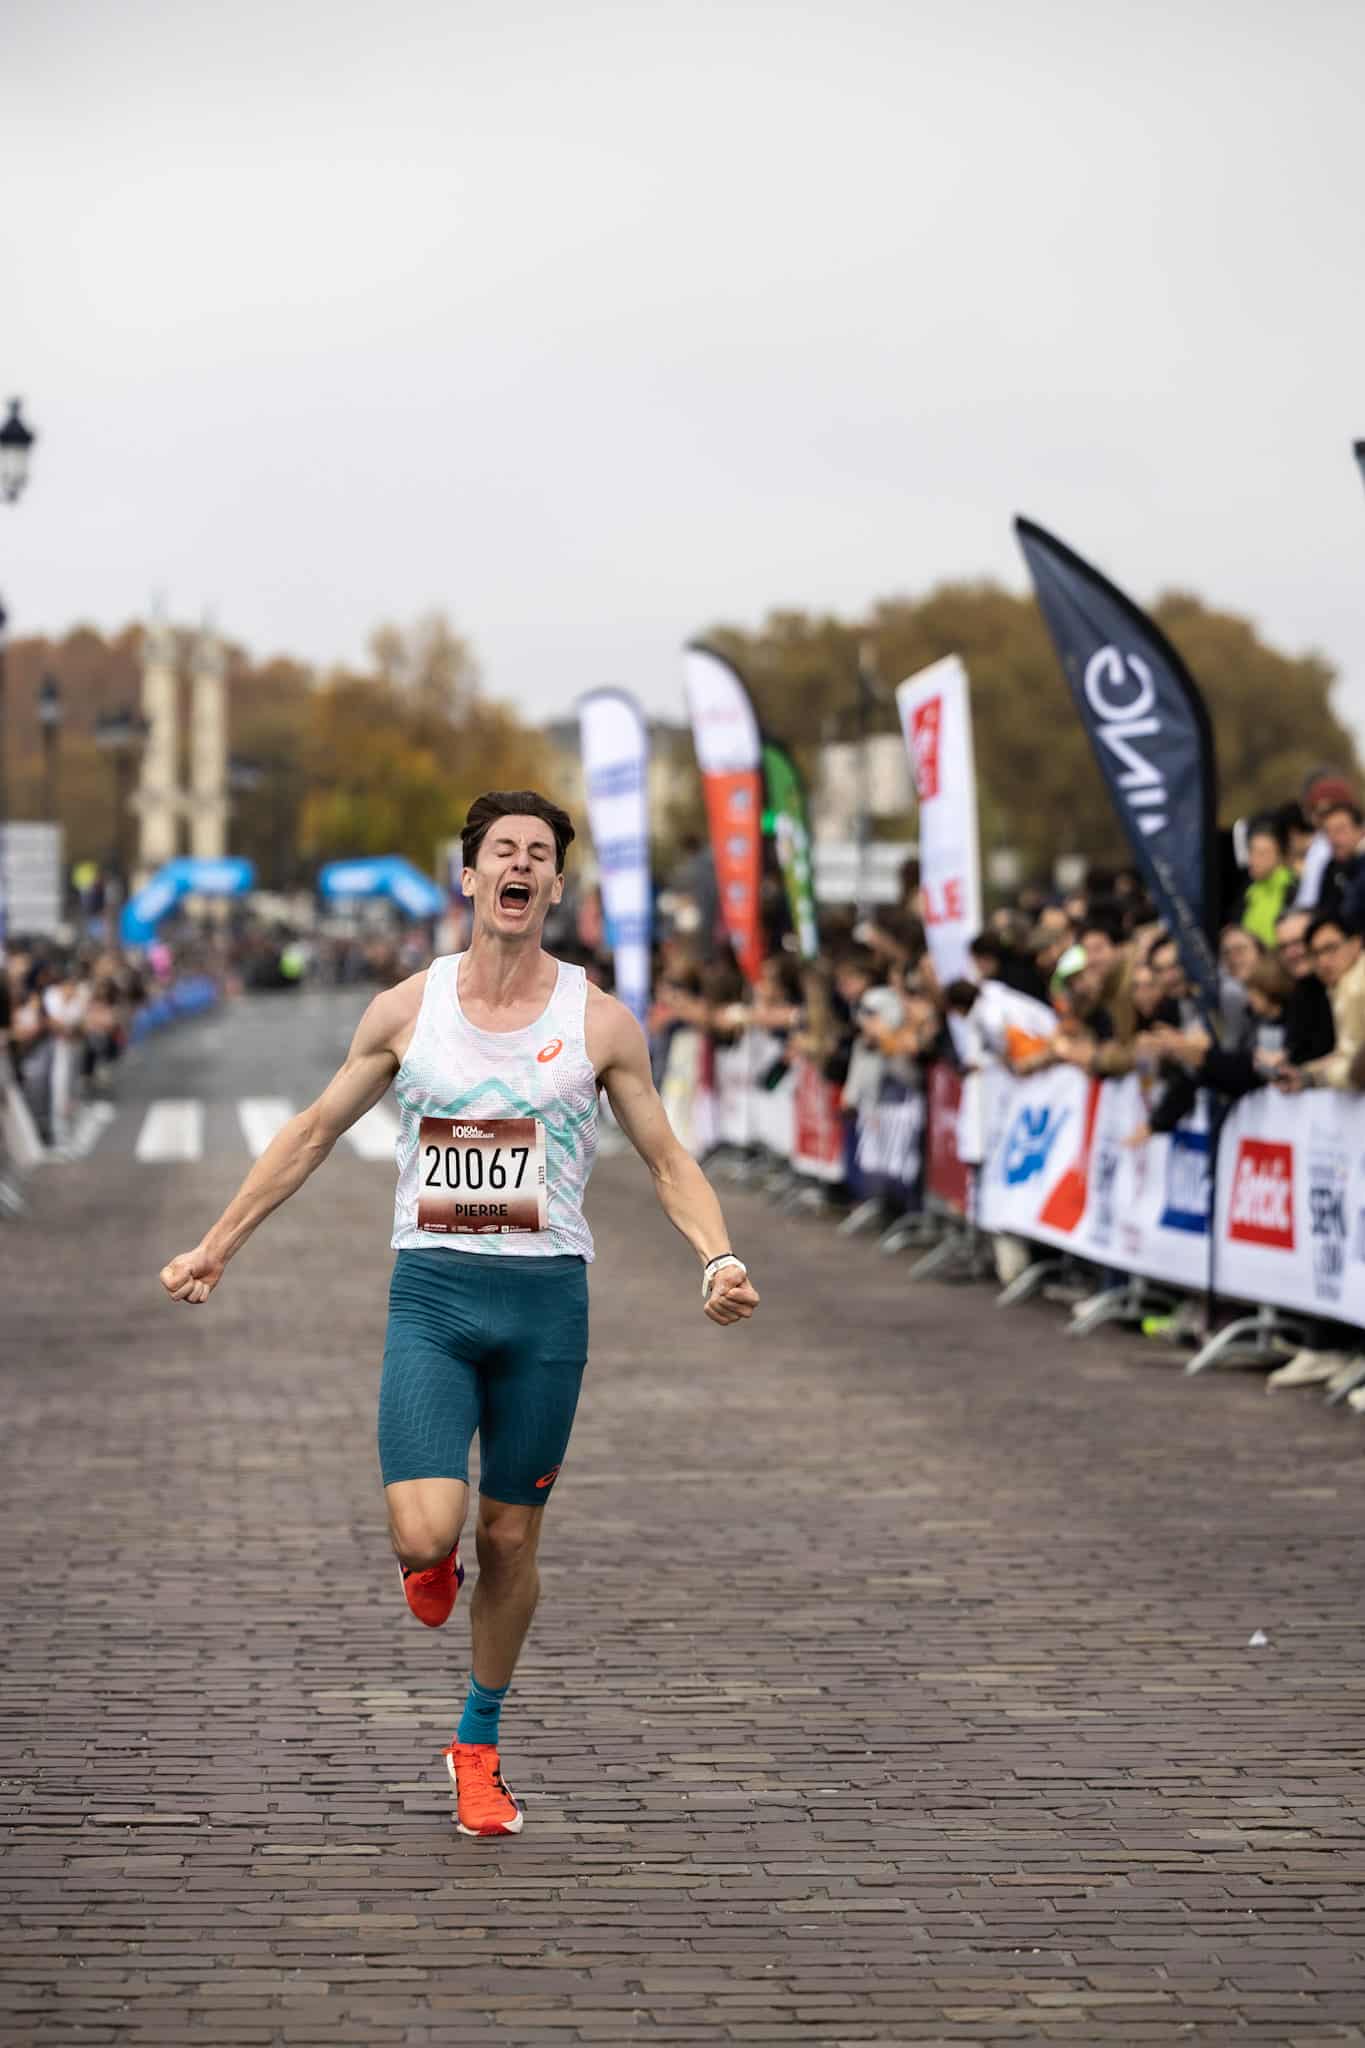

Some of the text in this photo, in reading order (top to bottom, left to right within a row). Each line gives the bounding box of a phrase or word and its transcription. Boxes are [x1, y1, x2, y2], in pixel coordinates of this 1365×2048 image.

[452, 1125, 464, 1138] 10
[425, 1145, 529, 1190] 20067
[455, 1203, 508, 1217] PIERRE
